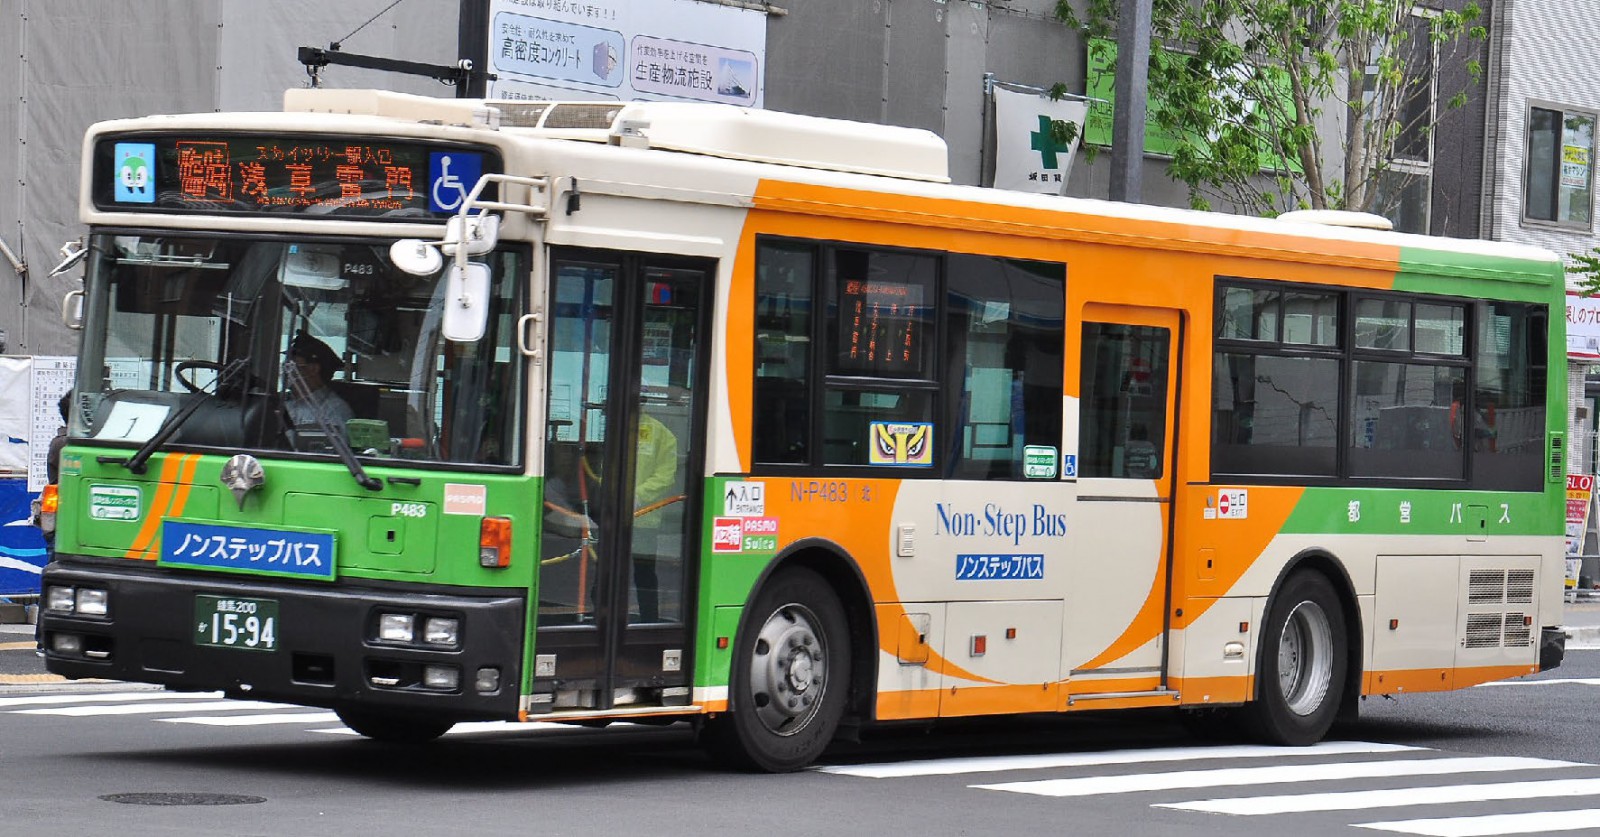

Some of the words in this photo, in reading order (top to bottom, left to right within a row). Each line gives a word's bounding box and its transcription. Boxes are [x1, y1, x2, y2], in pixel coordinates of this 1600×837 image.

[501, 37, 582, 69] 高密度コンクリート
[635, 60, 713, 90] 生産物流施設
[256, 145, 393, 165] スカイツリー駅入口
[181, 147, 227, 198] 臨時
[239, 161, 415, 200] 浅草雷門
[344, 263, 373, 275] P483
[740, 486, 760, 501] 入口
[791, 481, 848, 502] N-P483
[1231, 493, 1245, 506] 出口
[391, 502, 427, 518] P483
[1032, 503, 1067, 537] Bus
[1348, 500, 1511, 524] 都営バス
[744, 520, 777, 532] PASMO
[173, 532, 322, 567] ノンステップバス
[744, 537, 775, 550] Suica
[957, 555, 1043, 579] ノンステップバス
[212, 612, 275, 648] 15-94
